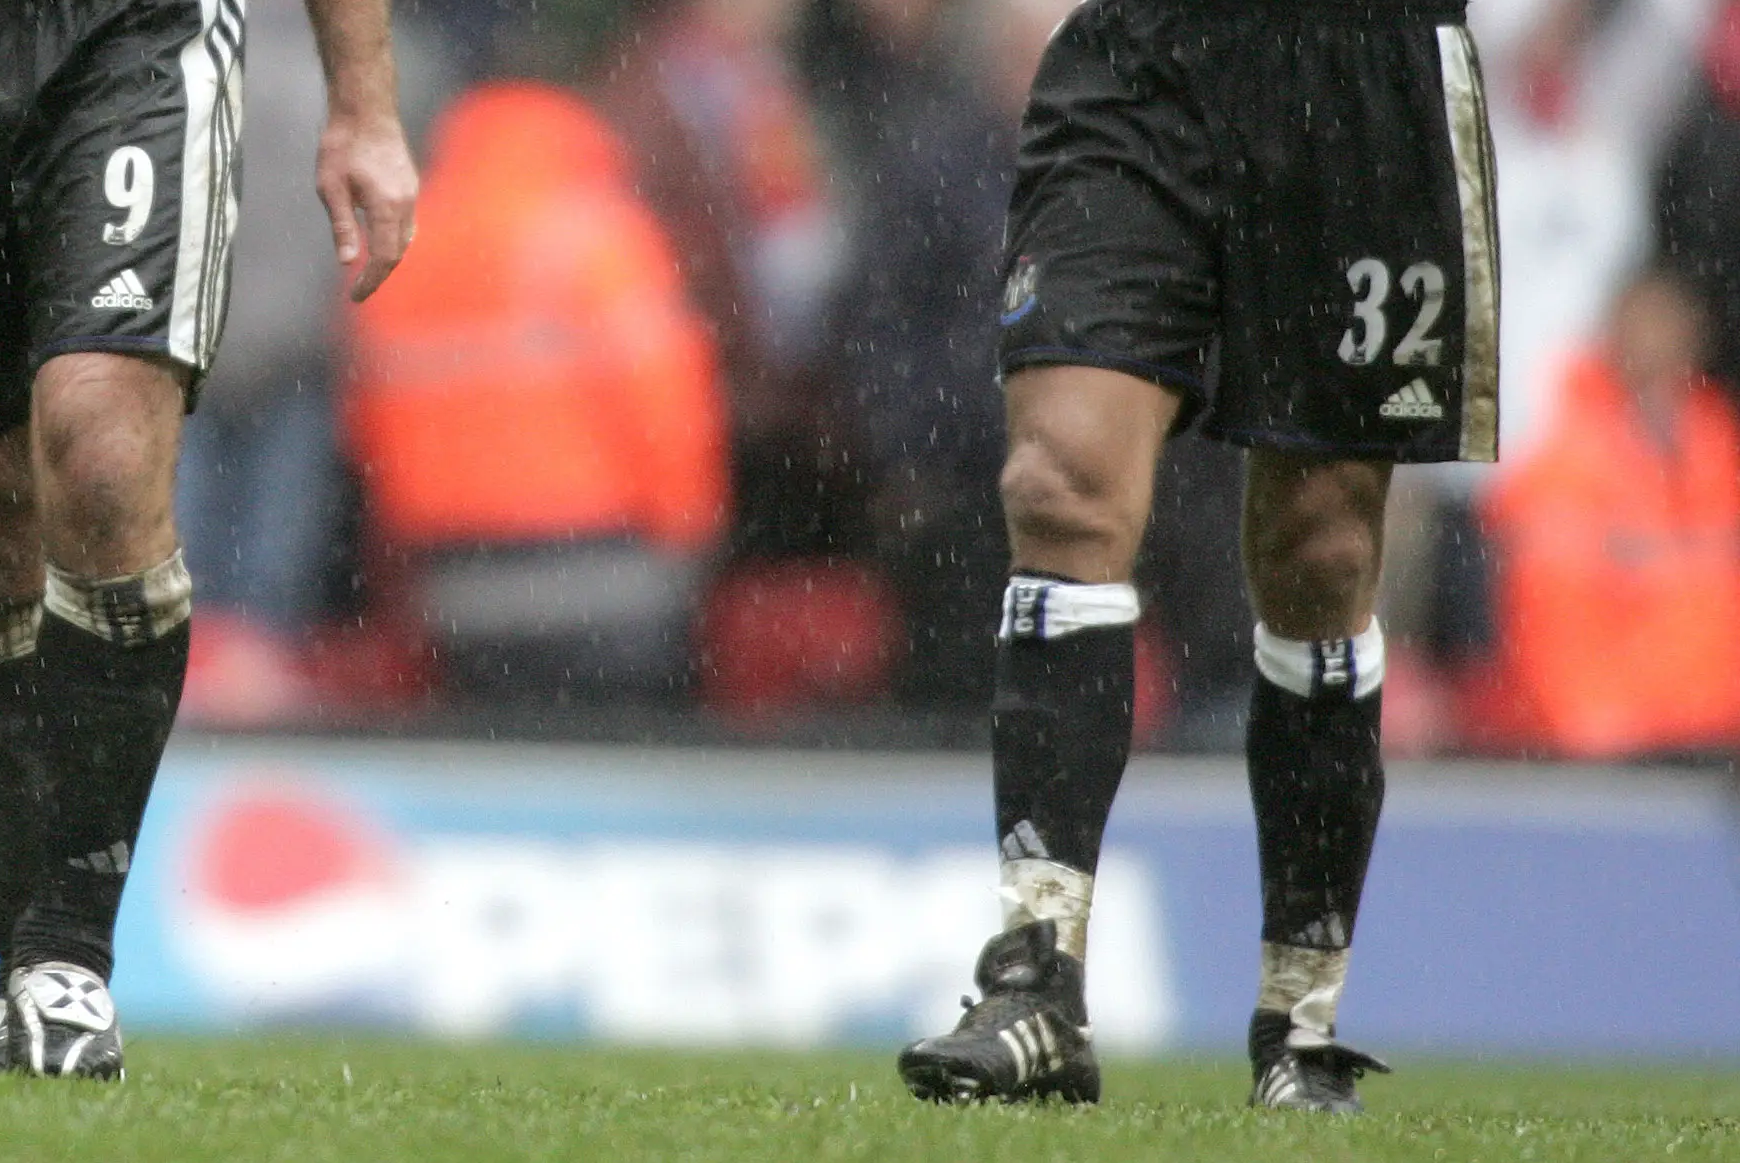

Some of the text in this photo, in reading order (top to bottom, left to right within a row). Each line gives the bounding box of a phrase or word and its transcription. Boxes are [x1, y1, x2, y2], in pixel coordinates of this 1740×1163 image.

[103, 145, 155, 246] 9
[91, 292, 154, 311] adidas
[1336, 257, 1447, 367] 32
[1378, 401, 1443, 418] adidas
